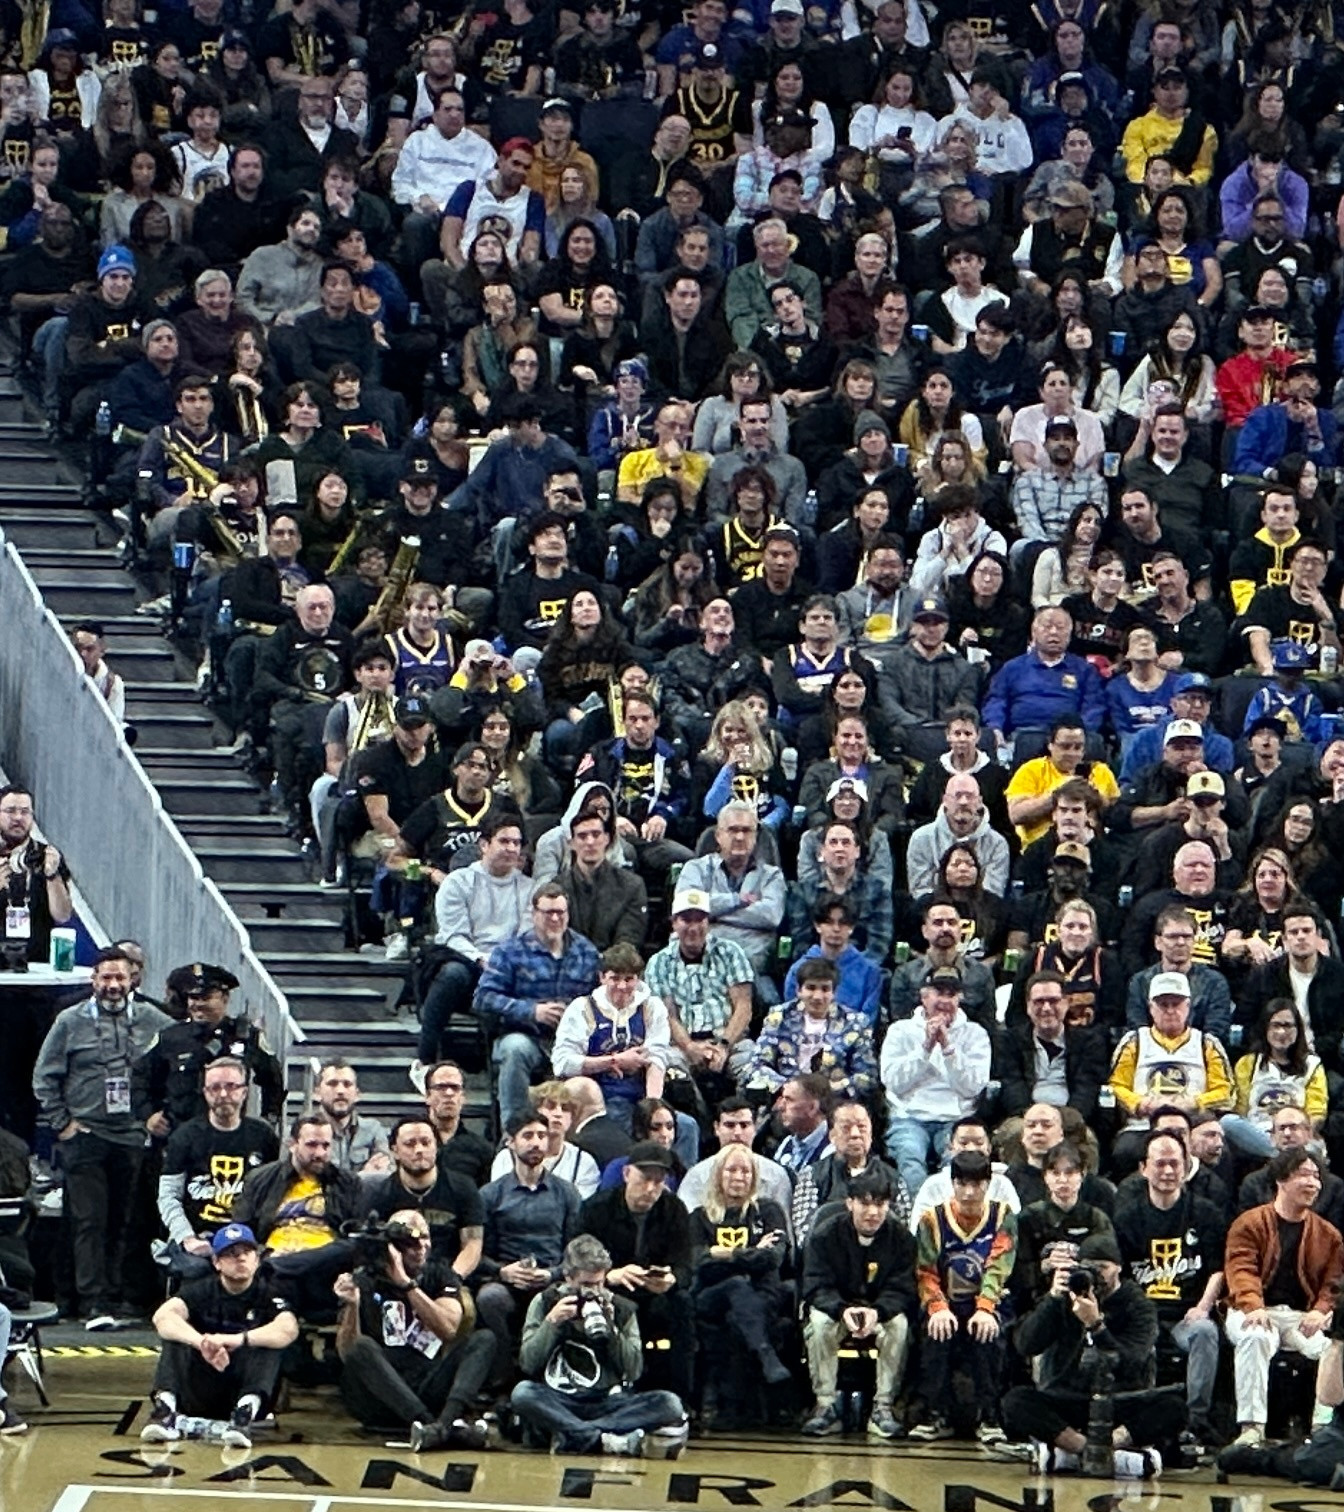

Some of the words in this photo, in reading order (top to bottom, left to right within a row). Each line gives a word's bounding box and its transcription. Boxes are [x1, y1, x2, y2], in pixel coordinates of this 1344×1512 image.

[692, 142, 724, 161] 30
[314, 673, 326, 690] 5
[92, 1448, 479, 1493] SAN
